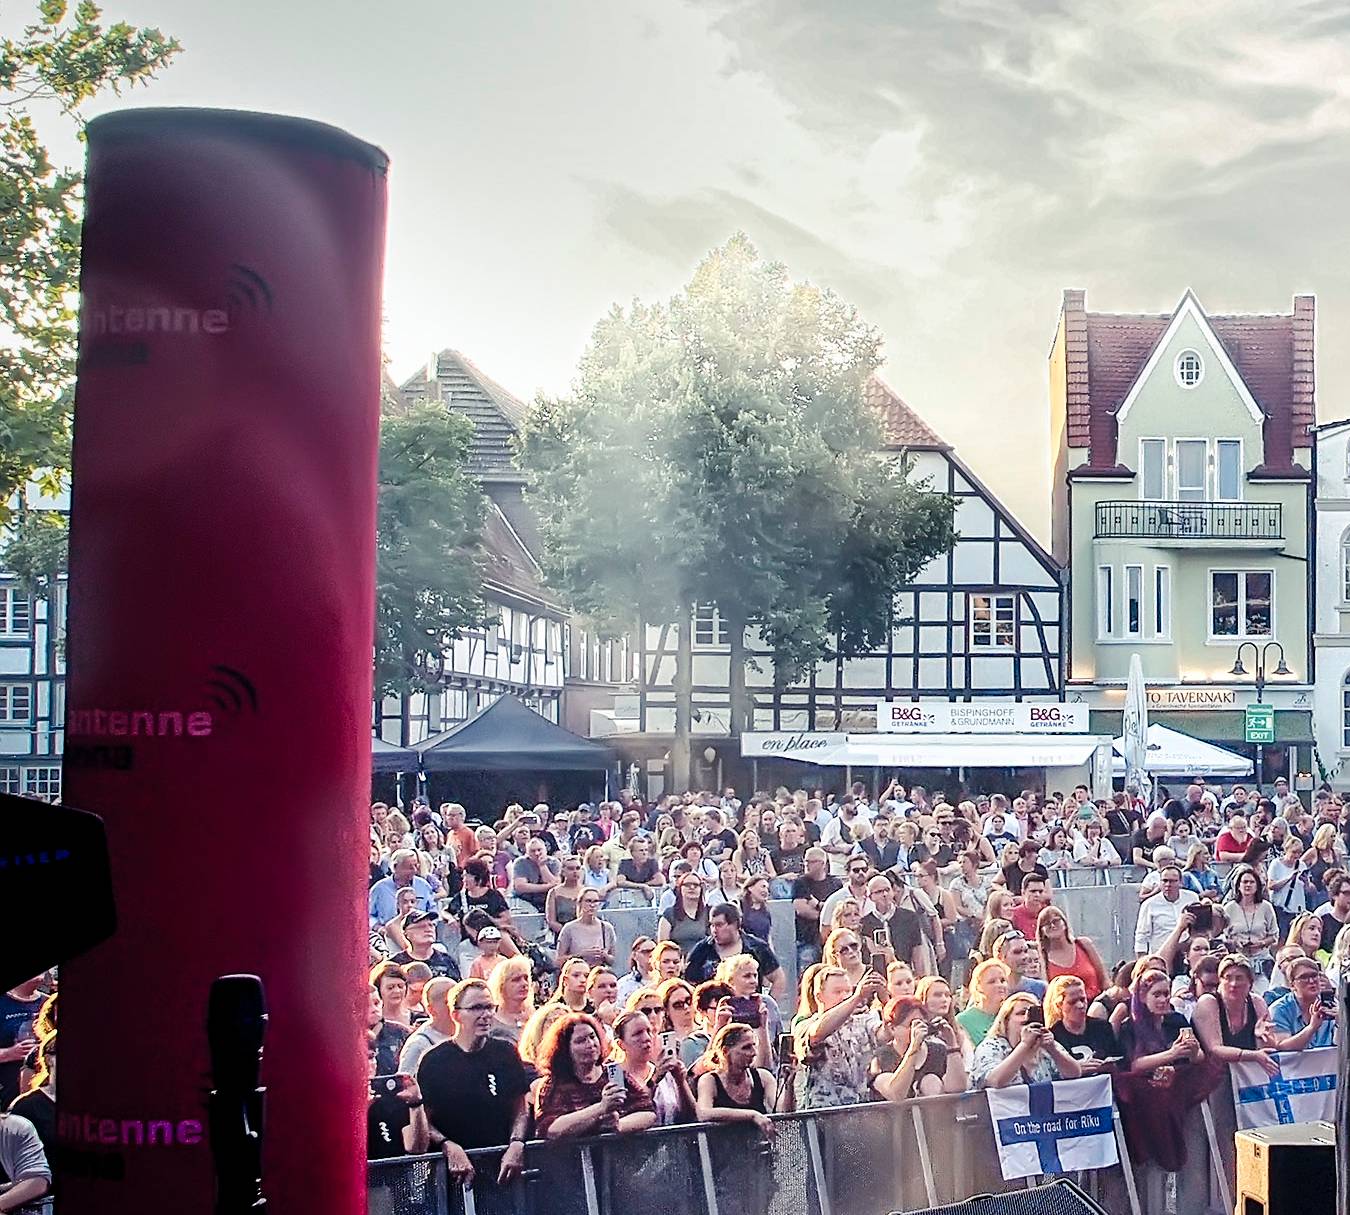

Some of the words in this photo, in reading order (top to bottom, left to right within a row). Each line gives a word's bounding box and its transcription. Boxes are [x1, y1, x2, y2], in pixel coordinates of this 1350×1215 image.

[83, 305, 229, 333] ntenne
[1166, 691, 1235, 703] TAVERNAKI
[892, 708, 921, 720] B&G
[1030, 708, 1060, 720] B&G
[1014, 1122, 1026, 1135] On
[1027, 1121, 1040, 1134] the
[1043, 1119, 1061, 1132] road
[1065, 1117, 1078, 1130] for
[1081, 1114, 1100, 1128] Riku
